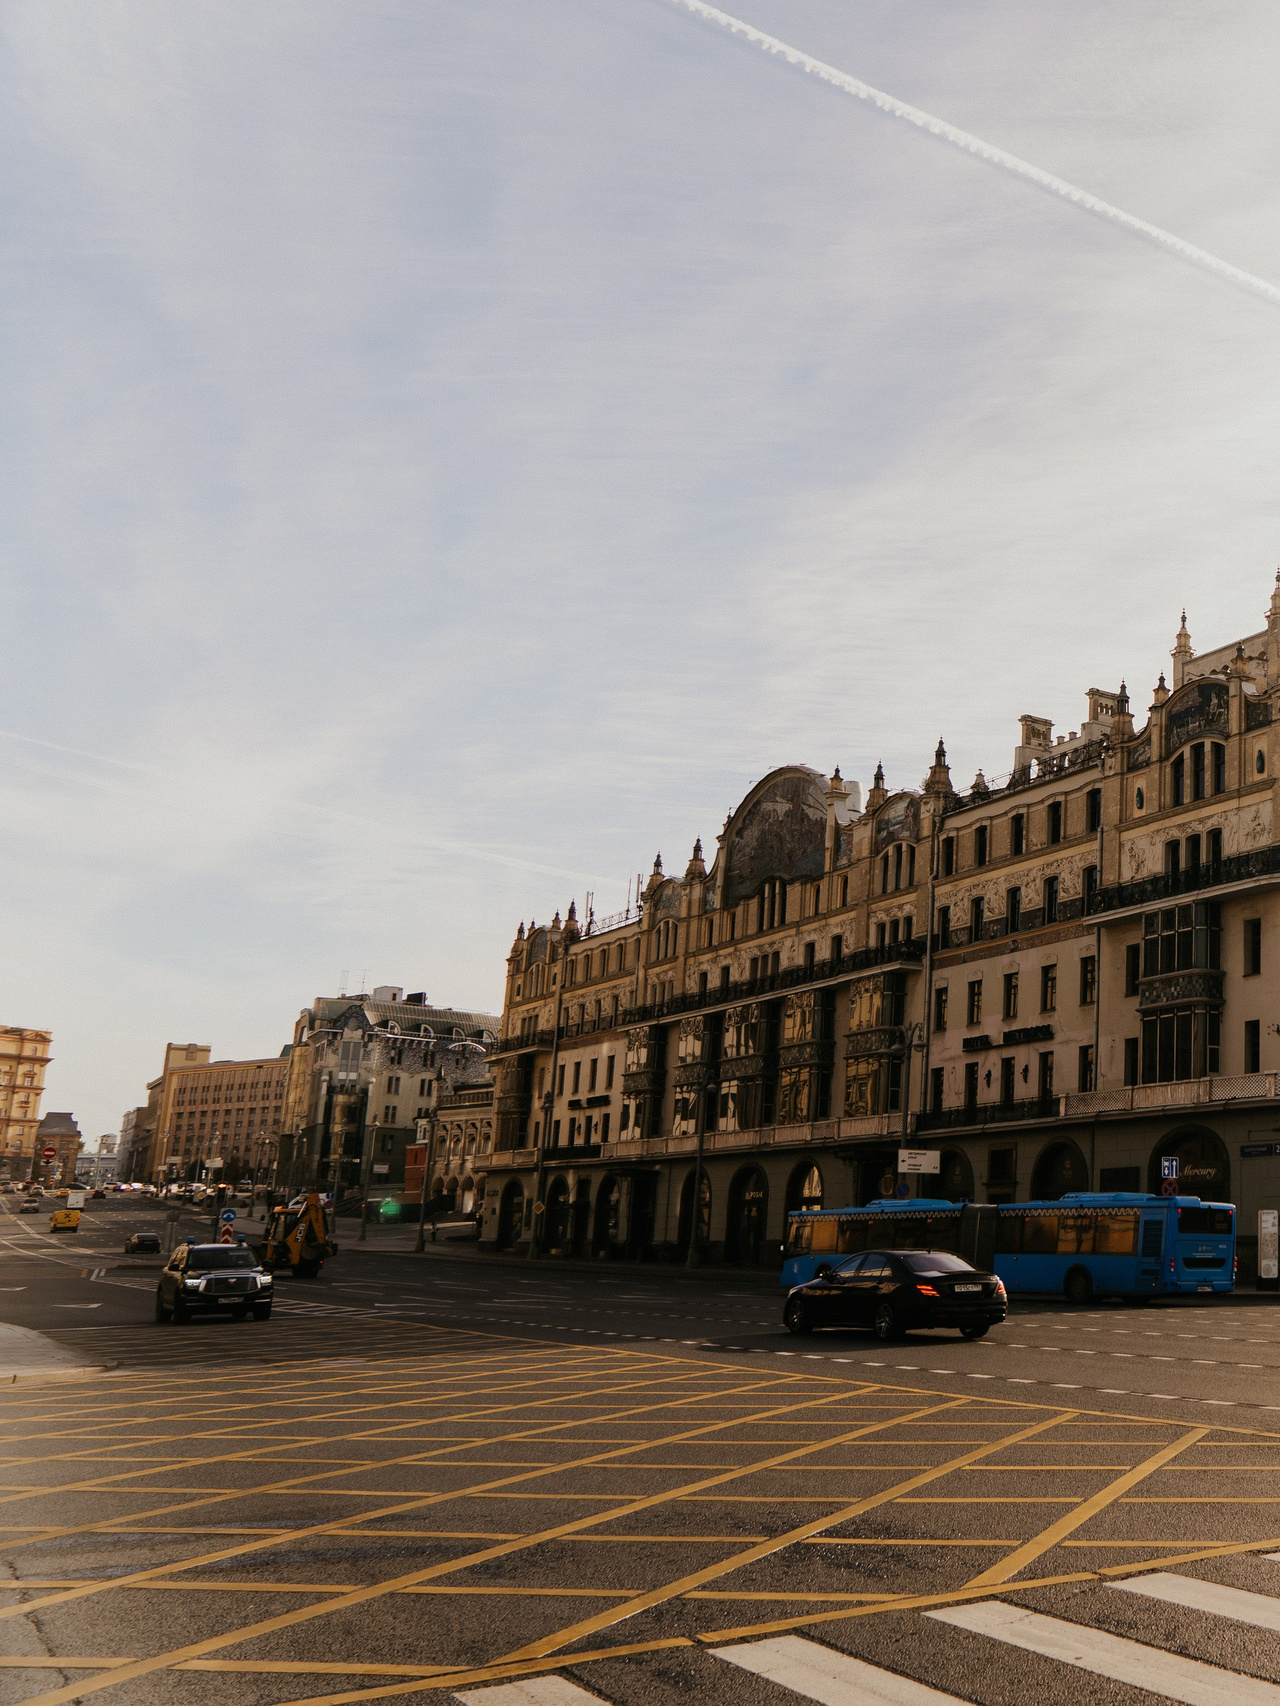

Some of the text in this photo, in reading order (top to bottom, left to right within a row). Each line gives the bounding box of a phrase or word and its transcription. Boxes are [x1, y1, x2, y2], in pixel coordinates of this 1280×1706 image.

[1275, 1144, 1280, 1153] 2
[1180, 1164, 1216, 1180] Mercury
[296, 1223, 306, 1243] JCB
